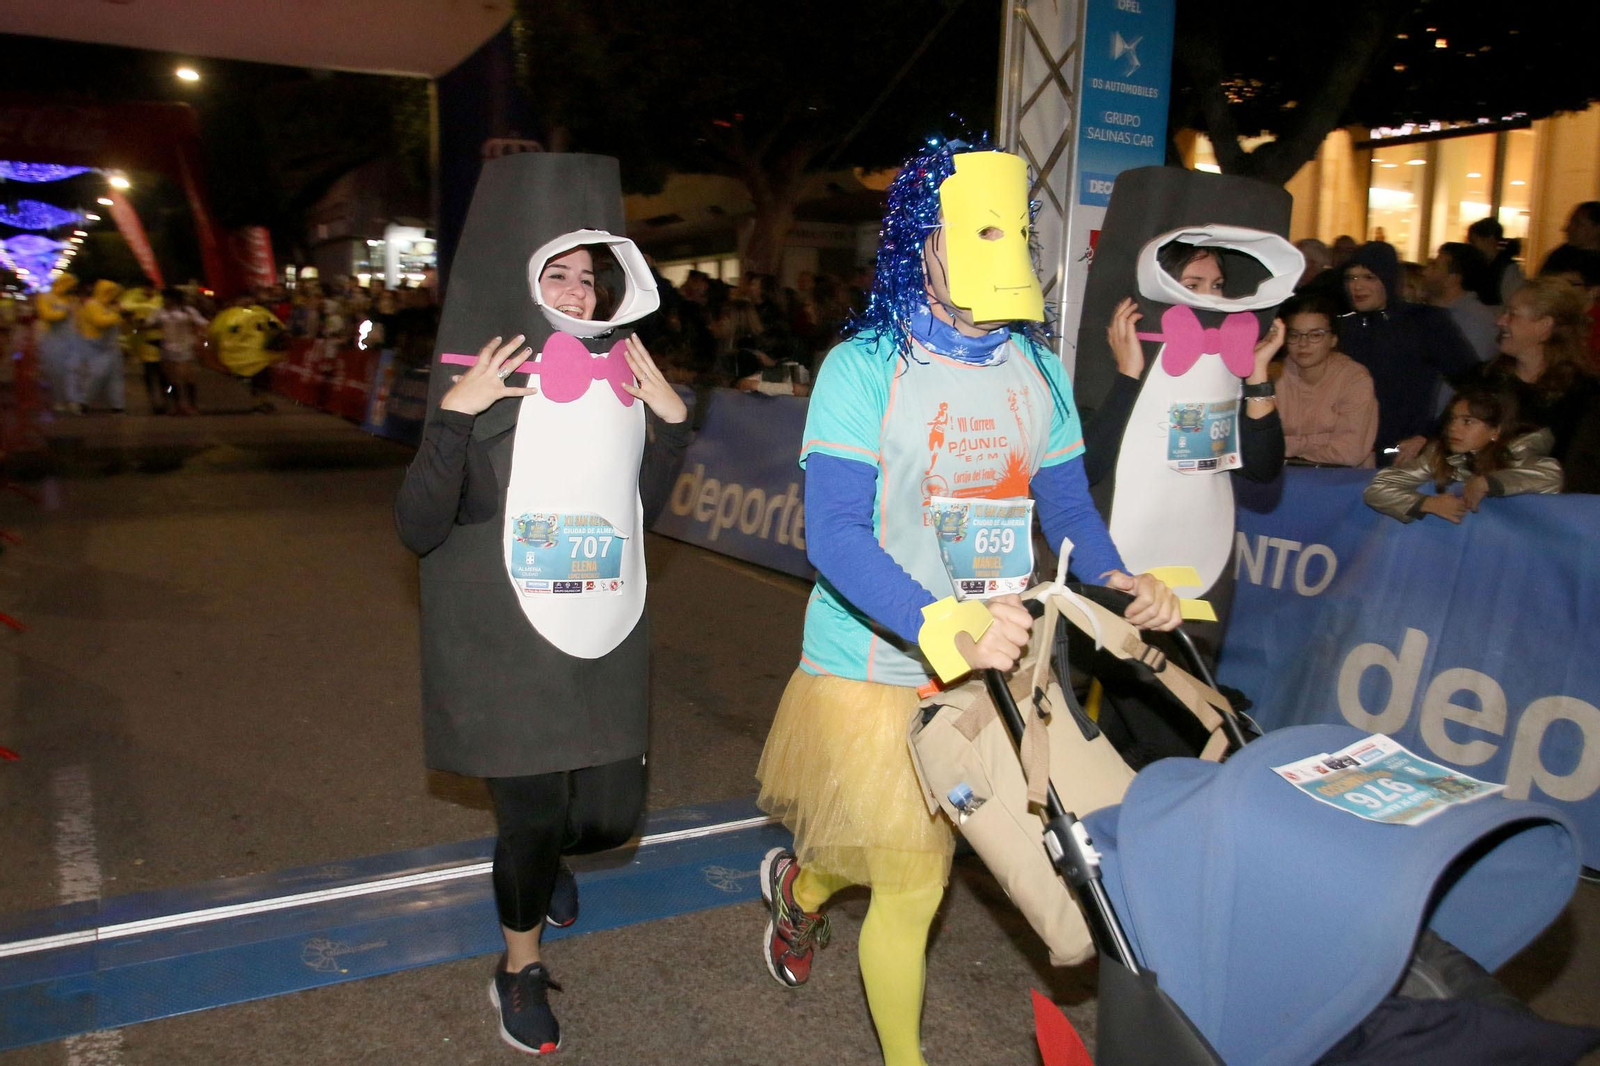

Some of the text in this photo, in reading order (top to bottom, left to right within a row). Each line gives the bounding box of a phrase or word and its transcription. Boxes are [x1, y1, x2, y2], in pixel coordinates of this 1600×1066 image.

[1118, 0, 1142, 14] OPEL
[1105, 80, 1159, 98] AUTOMOBILES
[1104, 111, 1141, 128] GRUPO
[1087, 127, 1154, 147] SALINAS CAR
[568, 536, 613, 559] 707
[974, 528, 1015, 554] 659
[572, 561, 597, 572] ELENA
[1343, 777, 1416, 810] 976
